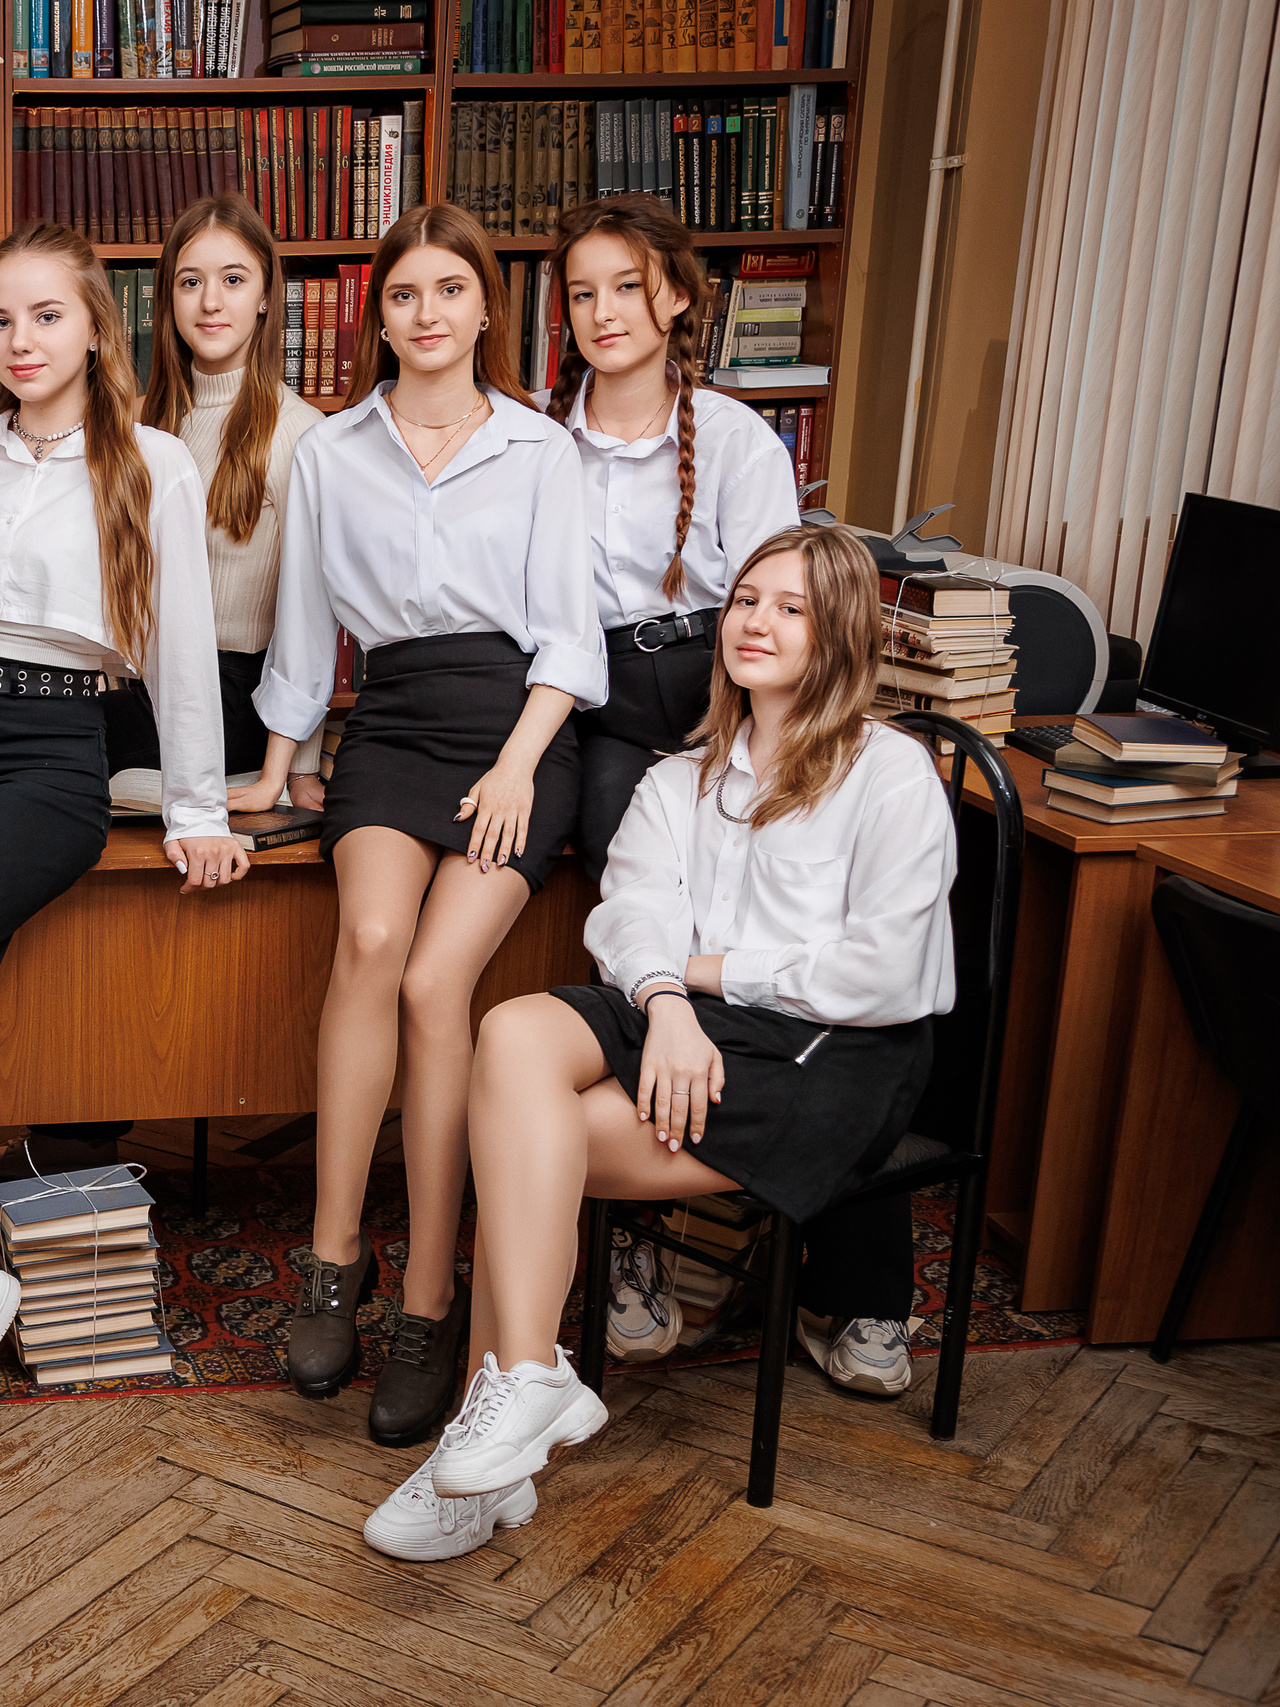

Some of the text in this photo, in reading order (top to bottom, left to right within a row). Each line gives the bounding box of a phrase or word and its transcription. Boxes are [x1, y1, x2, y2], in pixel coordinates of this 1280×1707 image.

[206, 6, 217, 70] ЭНЦИКЛОПЕДИЯ
[218, 7, 230, 70] ЭНЦИКЛОПЕДИЯ
[678, 118, 684, 130] 1
[692, 119, 699, 130] 2
[711, 120, 718, 132] 3
[729, 118, 737, 129] 4
[382, 144, 393, 226] ЭНЦИКЛОПЕДИЯ
